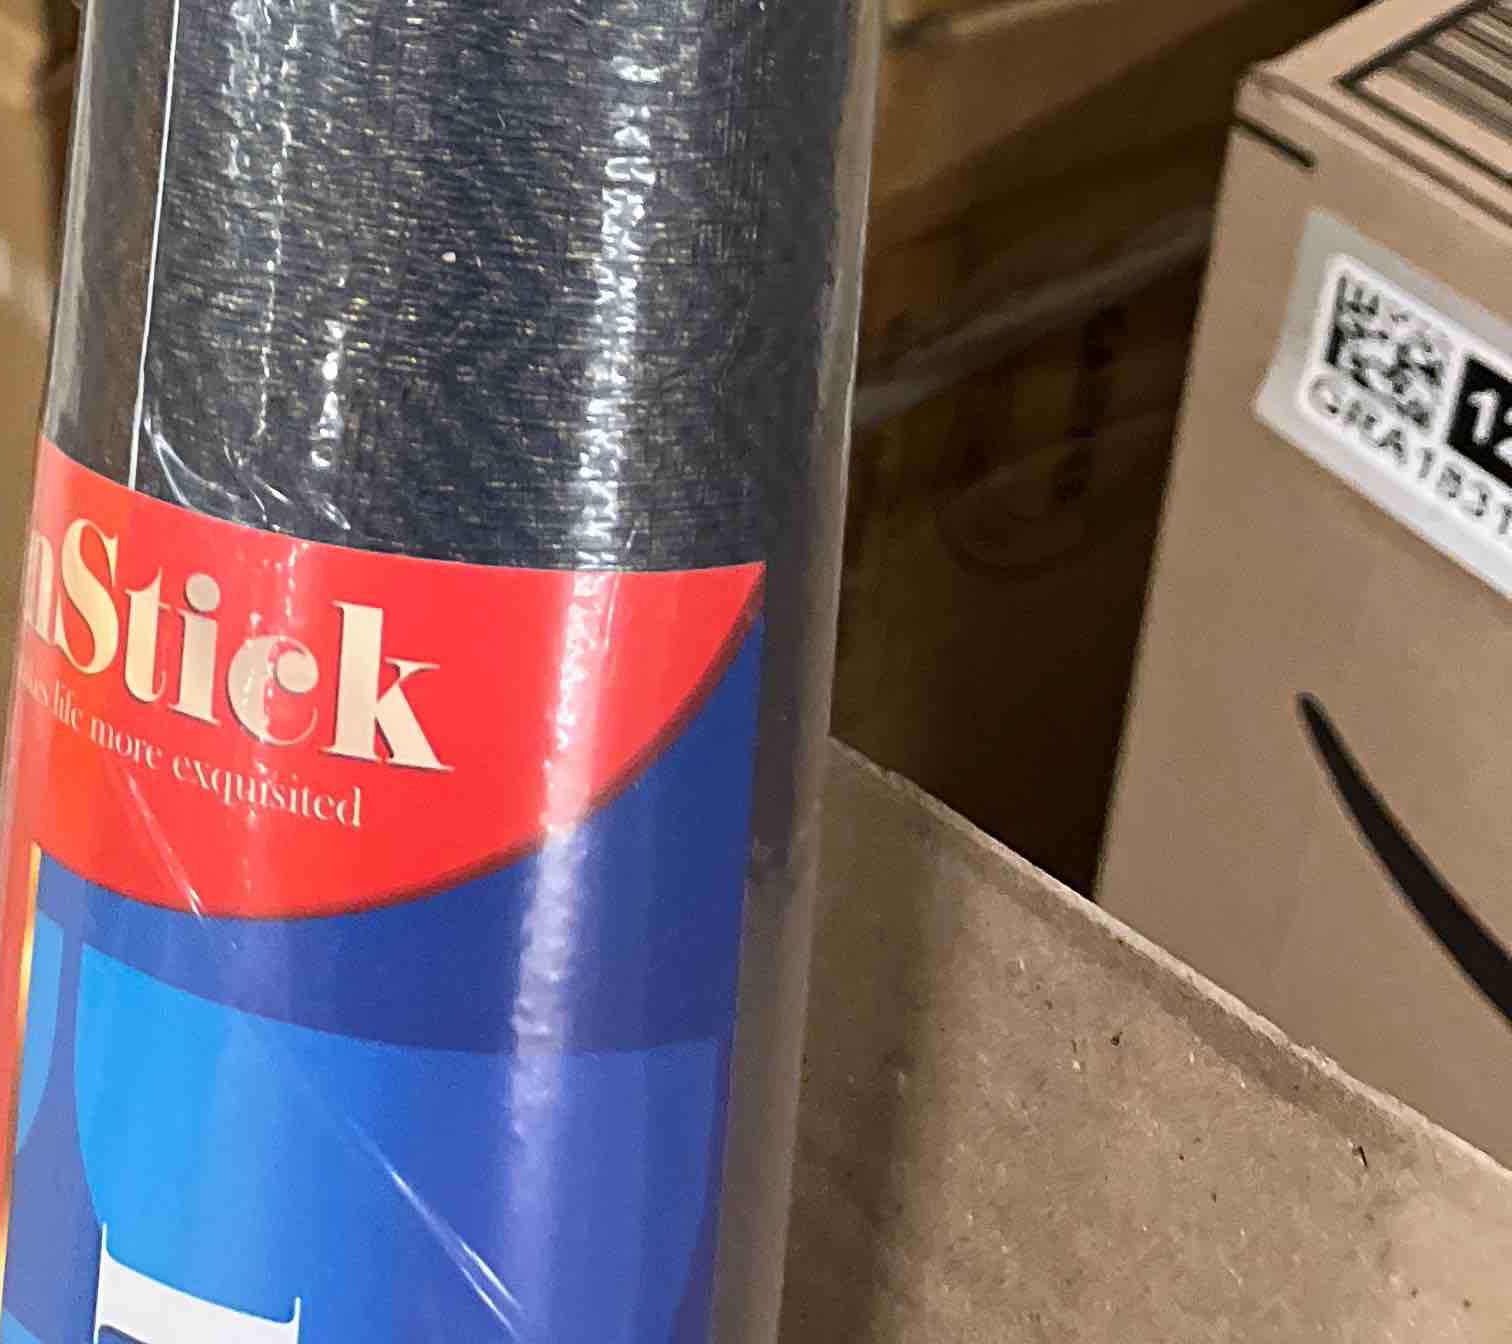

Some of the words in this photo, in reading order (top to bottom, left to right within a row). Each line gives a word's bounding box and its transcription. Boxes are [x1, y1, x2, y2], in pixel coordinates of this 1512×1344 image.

[23, 518, 456, 773] nStick
[89, 717, 164, 770] more
[172, 755, 362, 829] exquisited
